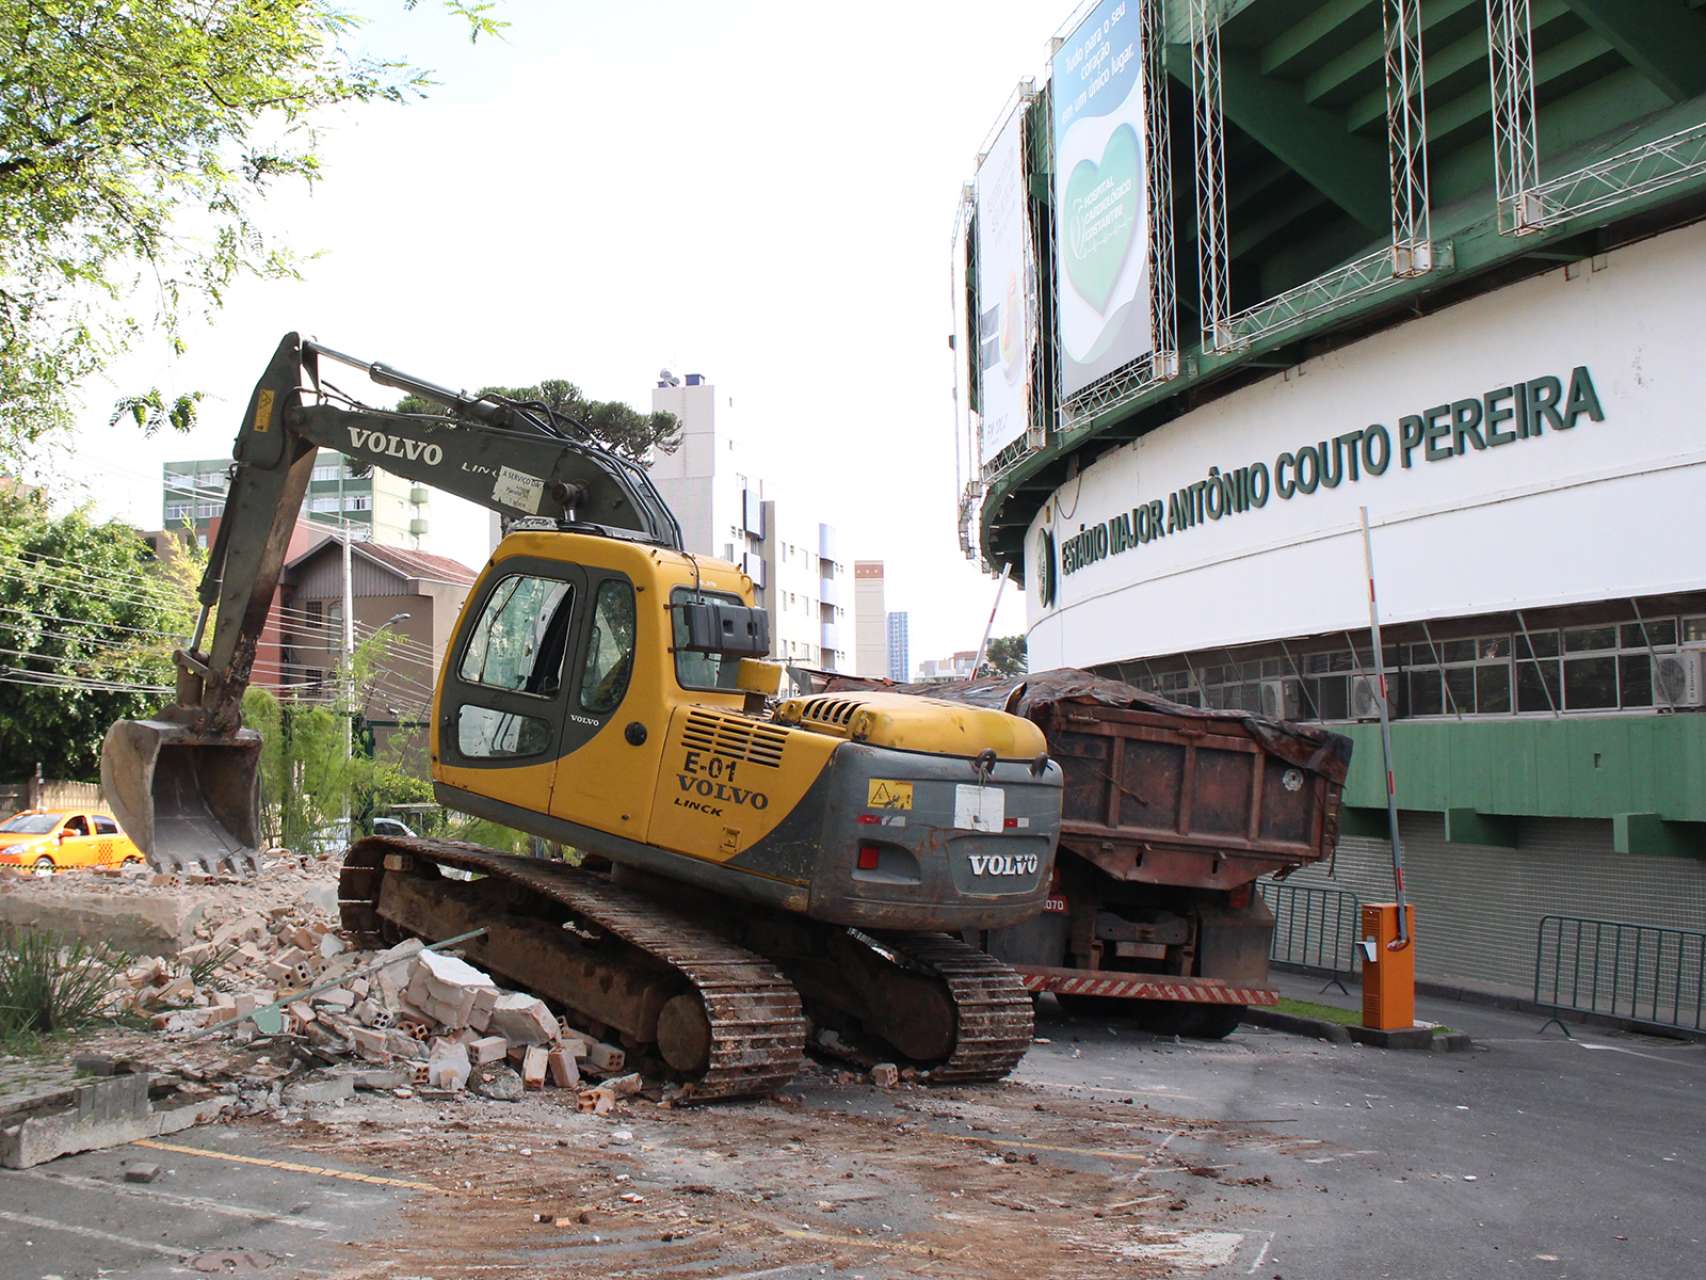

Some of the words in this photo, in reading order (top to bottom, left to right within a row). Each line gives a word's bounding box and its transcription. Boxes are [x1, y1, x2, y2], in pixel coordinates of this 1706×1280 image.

[1084, 27, 1102, 60] para
[1103, 19, 1110, 34] o
[1111, 1, 1126, 27] seu
[1081, 39, 1111, 80] coração
[1074, 91, 1087, 112] um
[347, 426, 443, 466] VOLVO
[1061, 524, 1109, 576] ESTÁDIO
[1108, 499, 1165, 556] MAJOR
[1167, 465, 1270, 535] ANTÔNIO
[1274, 423, 1391, 500] COUTO
[1399, 366, 1606, 469] PEREIRA
[569, 714, 600, 727] VOLVO
[683, 750, 737, 783] E-01
[674, 797, 723, 817] LINCK
[676, 773, 769, 811] VOLVO
[968, 852, 1039, 877] VOLVO
[1044, 899, 1064, 911] 070
